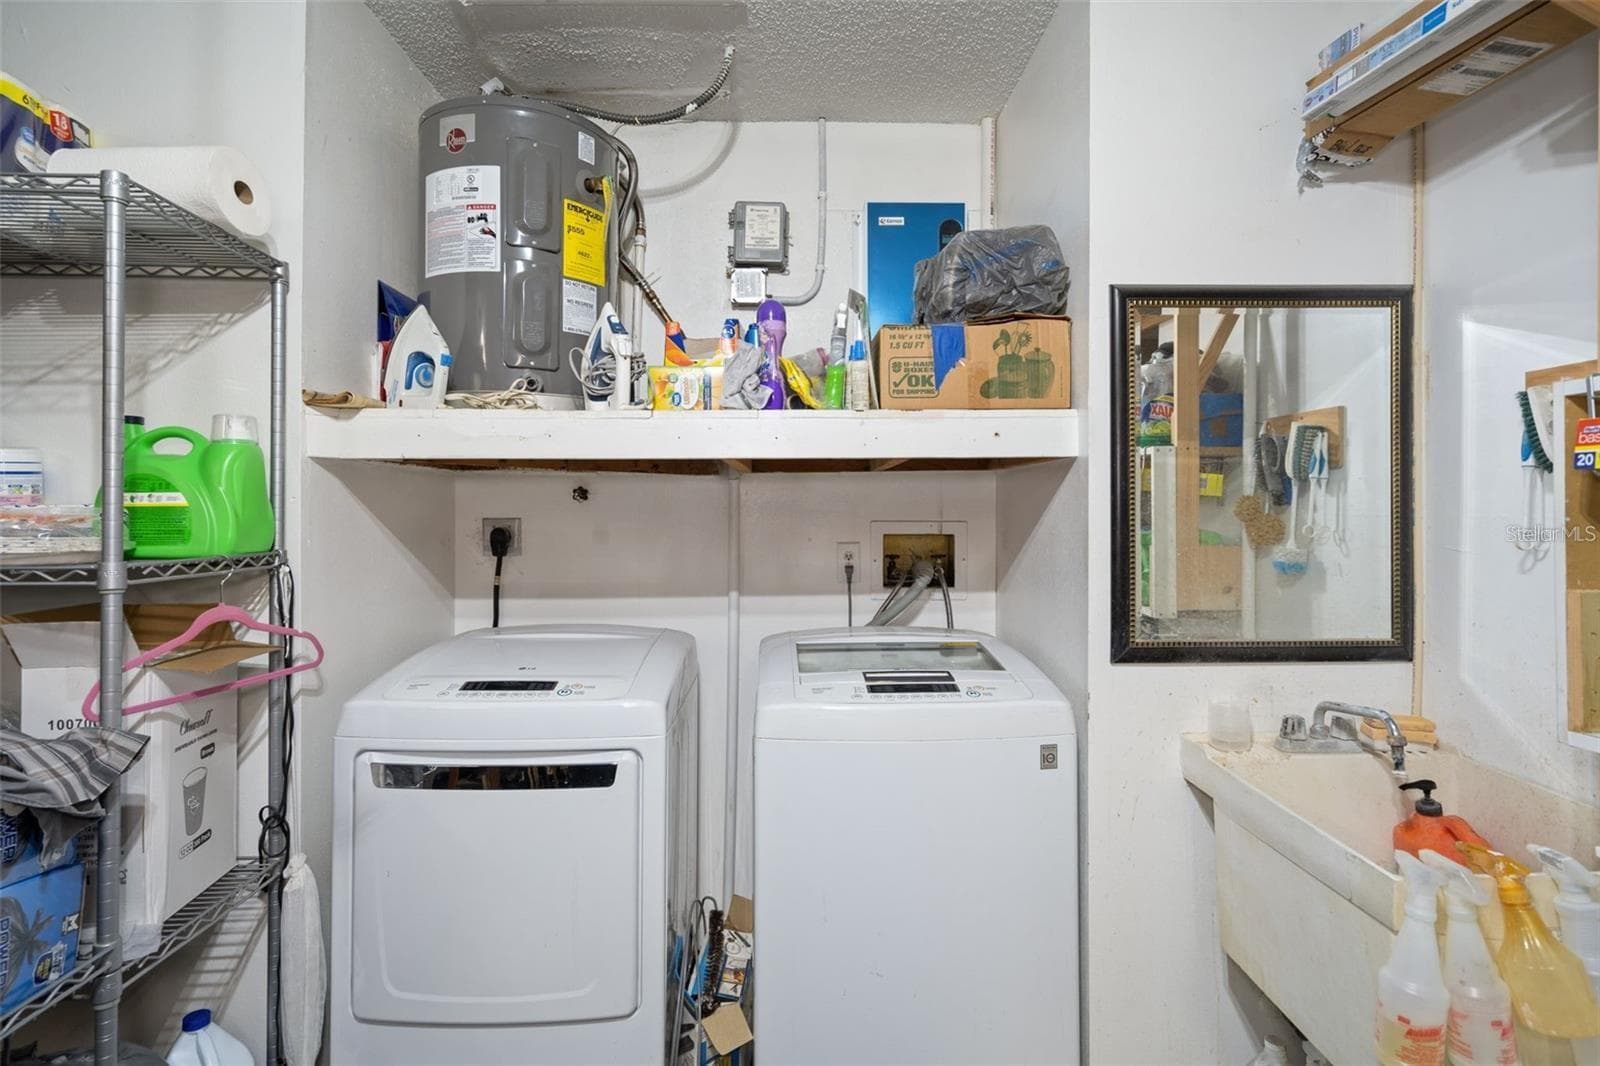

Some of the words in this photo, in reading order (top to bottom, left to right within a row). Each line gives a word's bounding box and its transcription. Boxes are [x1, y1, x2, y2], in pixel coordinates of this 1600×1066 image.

[52, 112, 69, 131] 18
[889, 341, 901, 349] 1.5
[902, 341, 913, 349] CU
[914, 341, 925, 349] FT
[907, 374, 935, 387] OK
[1576, 453, 1594, 467] 20
